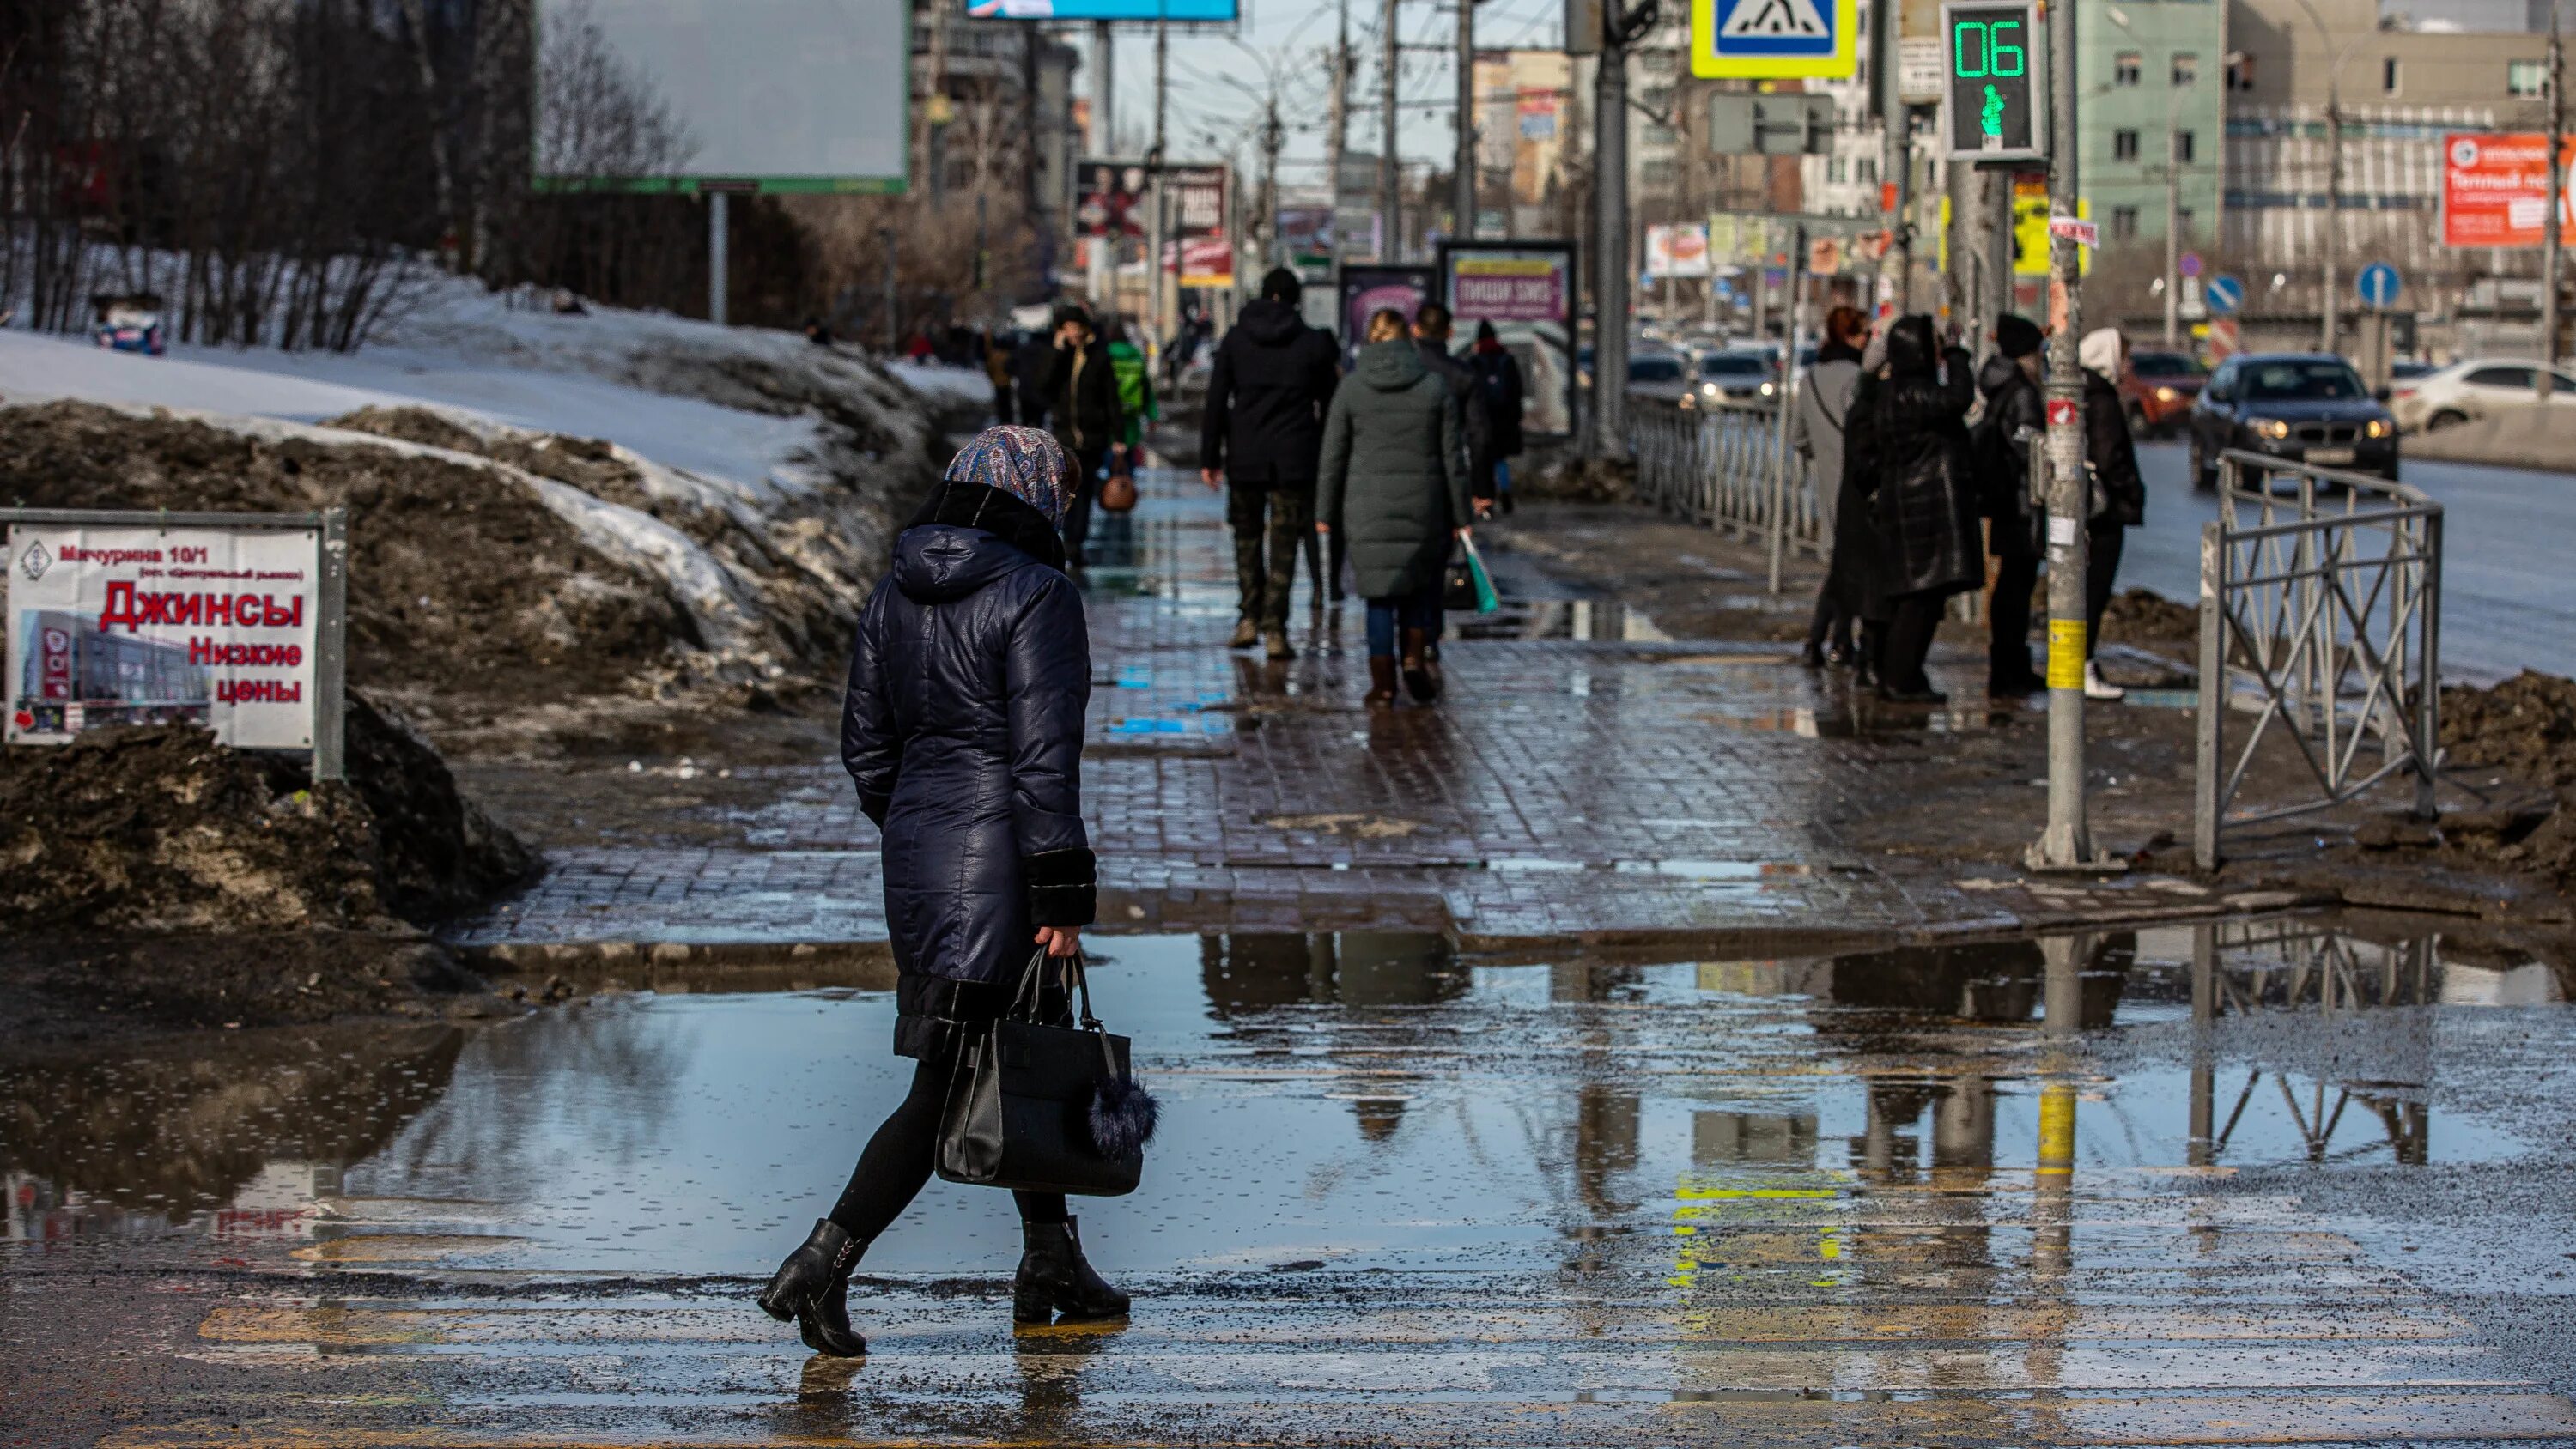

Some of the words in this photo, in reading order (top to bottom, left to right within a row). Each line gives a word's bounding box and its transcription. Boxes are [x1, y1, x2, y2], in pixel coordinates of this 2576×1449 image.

[1955, 21, 2024, 77] 06
[60, 545, 162, 566] Мичурина
[169, 546, 208, 564] 10/1
[100, 580, 303, 633] Джинсы
[189, 636, 302, 667] Низкие
[217, 680, 301, 706] цены
